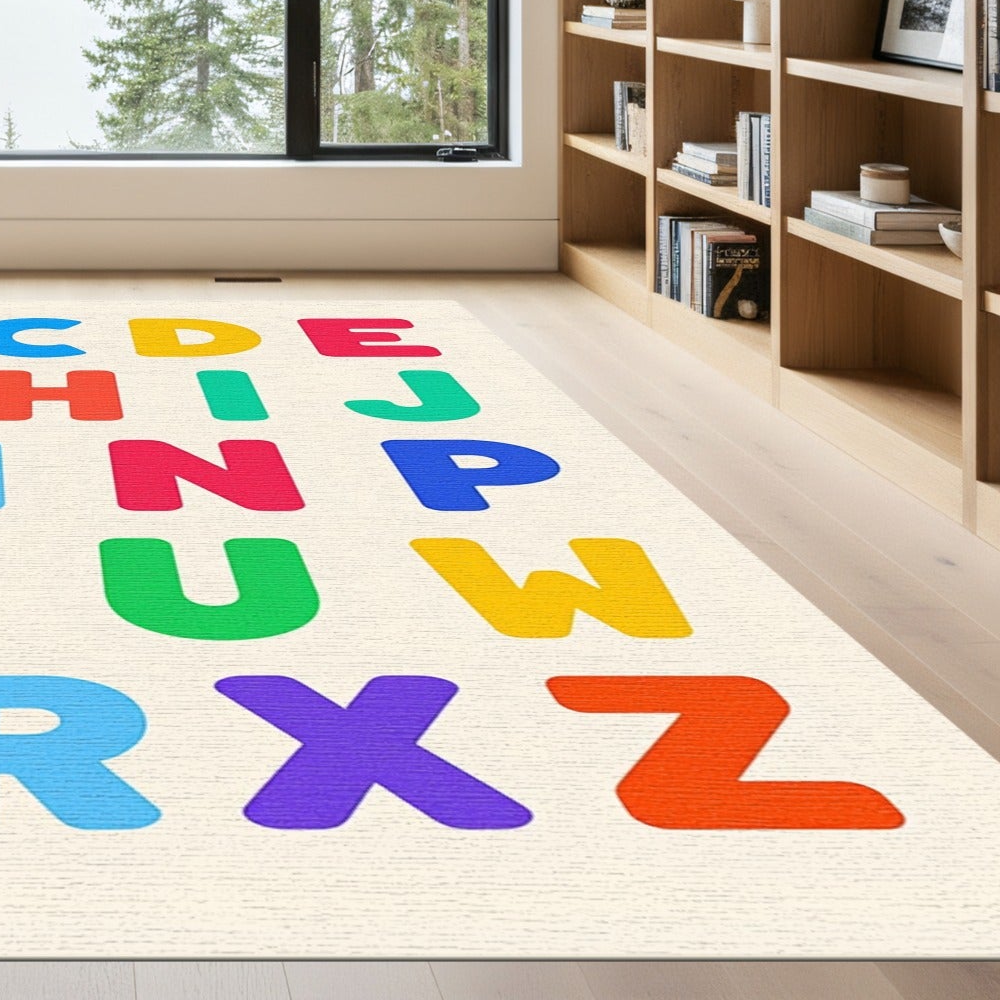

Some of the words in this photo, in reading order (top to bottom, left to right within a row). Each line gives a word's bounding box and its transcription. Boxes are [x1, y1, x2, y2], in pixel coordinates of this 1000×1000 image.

[128, 318, 262, 358] D
[298, 318, 441, 358] E
[197, 370, 269, 422] I
[345, 370, 480, 422] J
[108, 440, 305, 511] N
[381, 440, 560, 511] P
[99, 538, 320, 640] U
[409, 537, 693, 639] W
[215, 676, 532, 830] X
[545, 675, 905, 830] Z
